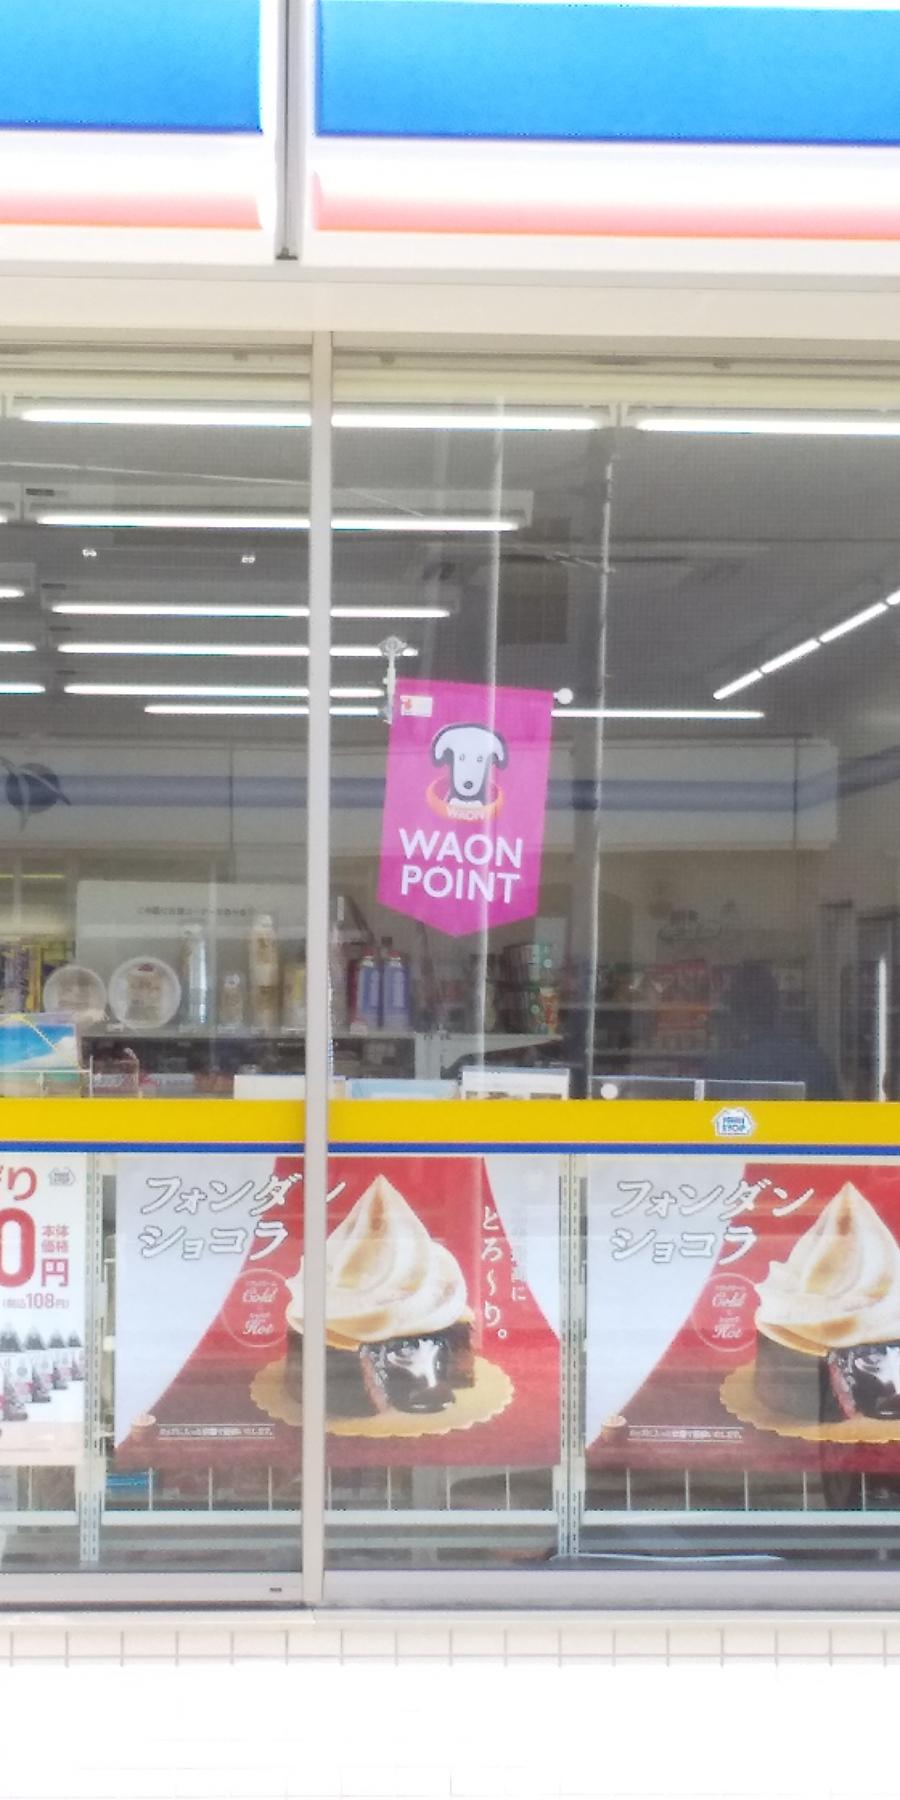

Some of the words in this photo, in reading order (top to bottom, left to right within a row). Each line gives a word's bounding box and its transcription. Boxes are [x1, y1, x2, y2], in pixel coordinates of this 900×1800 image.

[399, 827, 523, 869] WAON
[400, 864, 520, 904] POINT
[0, 1166, 37, 1201] り
[611, 1178, 814, 1221] フォンダン
[138, 1220, 289, 1261] ショコラ
[609, 1226, 757, 1265] ショコラ
[41, 1258, 69, 1287] 円
